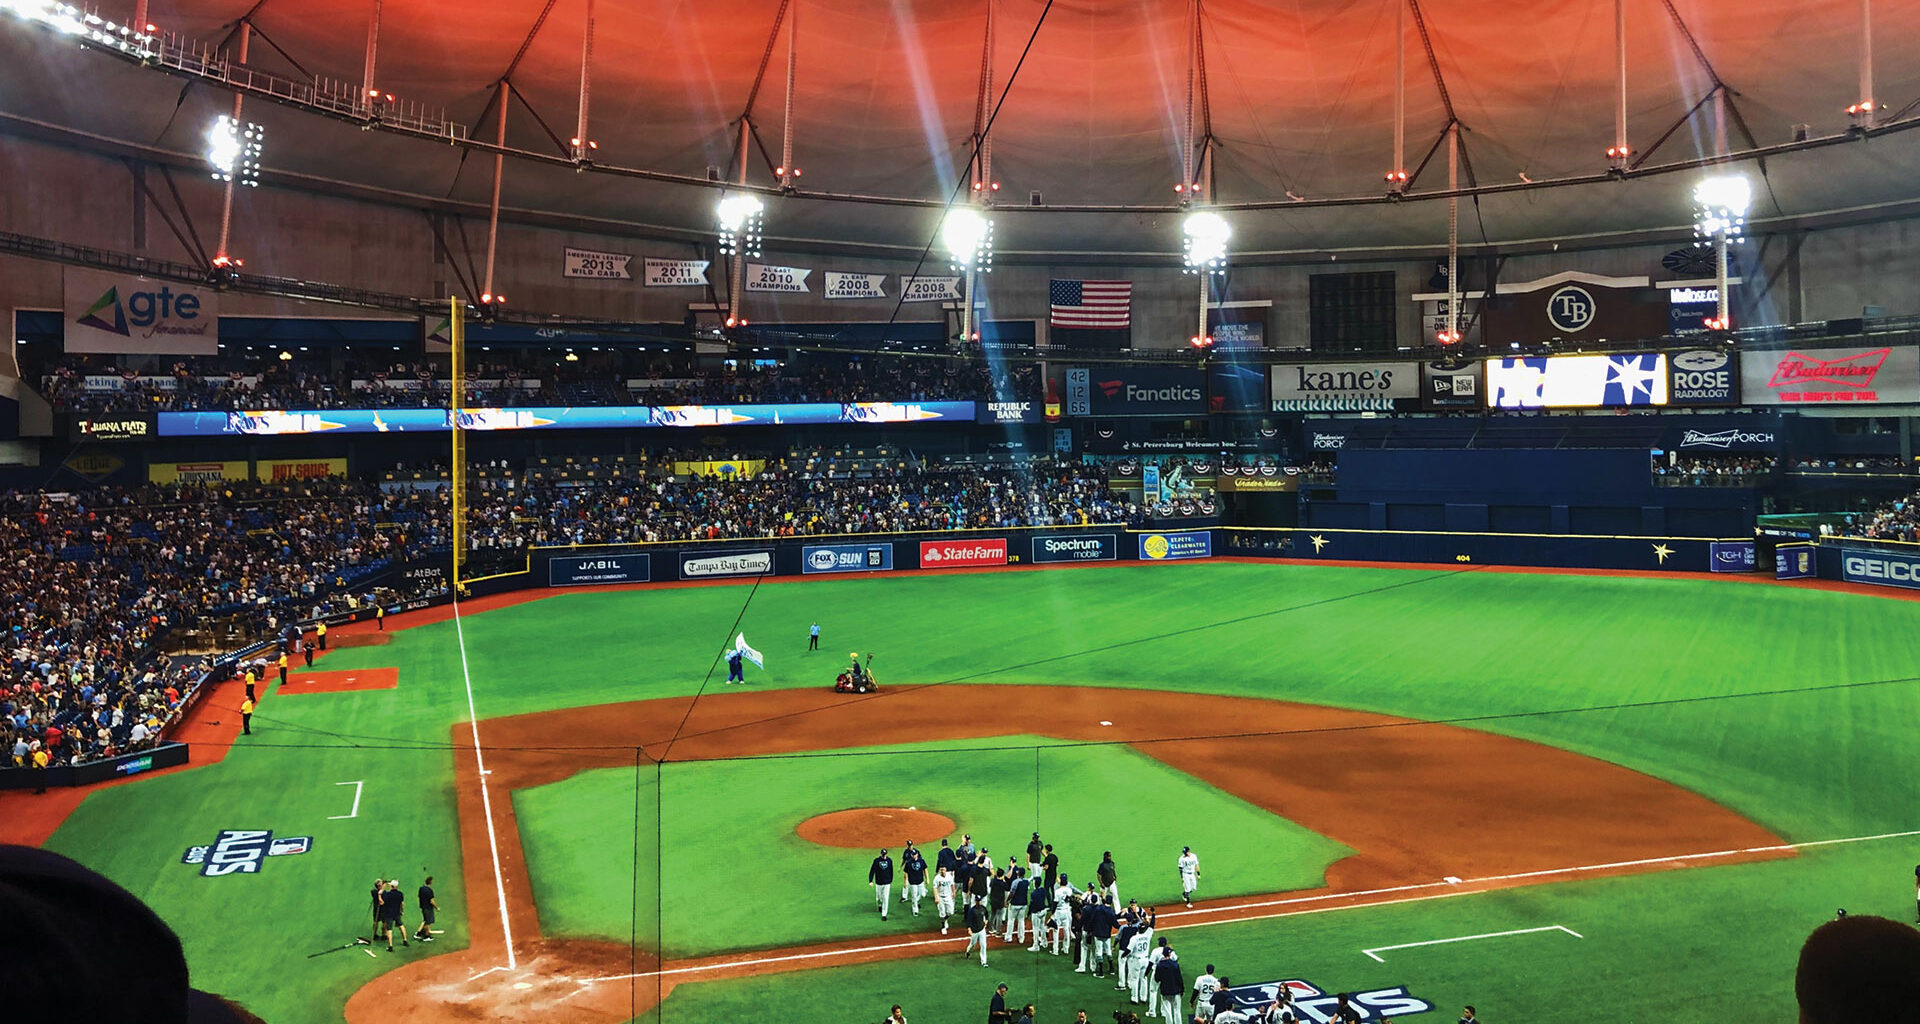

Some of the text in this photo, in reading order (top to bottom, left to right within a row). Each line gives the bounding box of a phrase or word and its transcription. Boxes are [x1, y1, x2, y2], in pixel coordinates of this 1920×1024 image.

[567, 251, 600, 260] AMERICAN
[582, 259, 614, 270] 2013
[571, 268, 621, 278] WILD CARD
[661, 267, 691, 277] 2011
[760, 273, 793, 284] 2010
[750, 282, 801, 291] CHAMPIONS
[838, 280, 870, 290] 2008
[914, 284, 945, 293] 2008
[829, 289, 878, 297] CHAMPIONS
[129, 286, 200, 327] gte
[1556, 296, 1588, 323] TB
[1778, 361, 1879, 379] Budweiser
[1070, 372, 1086, 382] 42
[1296, 366, 1393, 392] kane's
[1674, 371, 1729, 388] ROSE
[1072, 386, 1084, 398] 12
[1126, 384, 1201, 401] Fanatics
[1674, 389, 1728, 398] RADIOLOGY
[988, 402, 1031, 412] REPUBLIC
[1071, 402, 1086, 413] 66
[996, 411, 1023, 419] BANK
[121, 420, 147, 432] FLATS
[1686, 433, 1774, 443] Budweiser PORCH
[1143, 441, 1184, 449] Petersburg
[1314, 440, 1345, 448] PORCH
[272, 463, 330, 479] HOT SAUCE
[178, 471, 223, 484] LOUISIANA
[1046, 539, 1100, 553] Spectrum
[815, 554, 832, 562] FOX
[839, 552, 862, 564] SUN
[1074, 550, 1099, 559] mobile
[1722, 551, 1742, 560] TGH
[579, 560, 621, 570] JABIL
[688, 558, 768, 574] Tampa Bay Times
[412, 600, 429, 608] ALDS
[206, 830, 268, 876] ALDS
[1138, 942, 1148, 952] 30
[1202, 984, 1214, 994] 25
